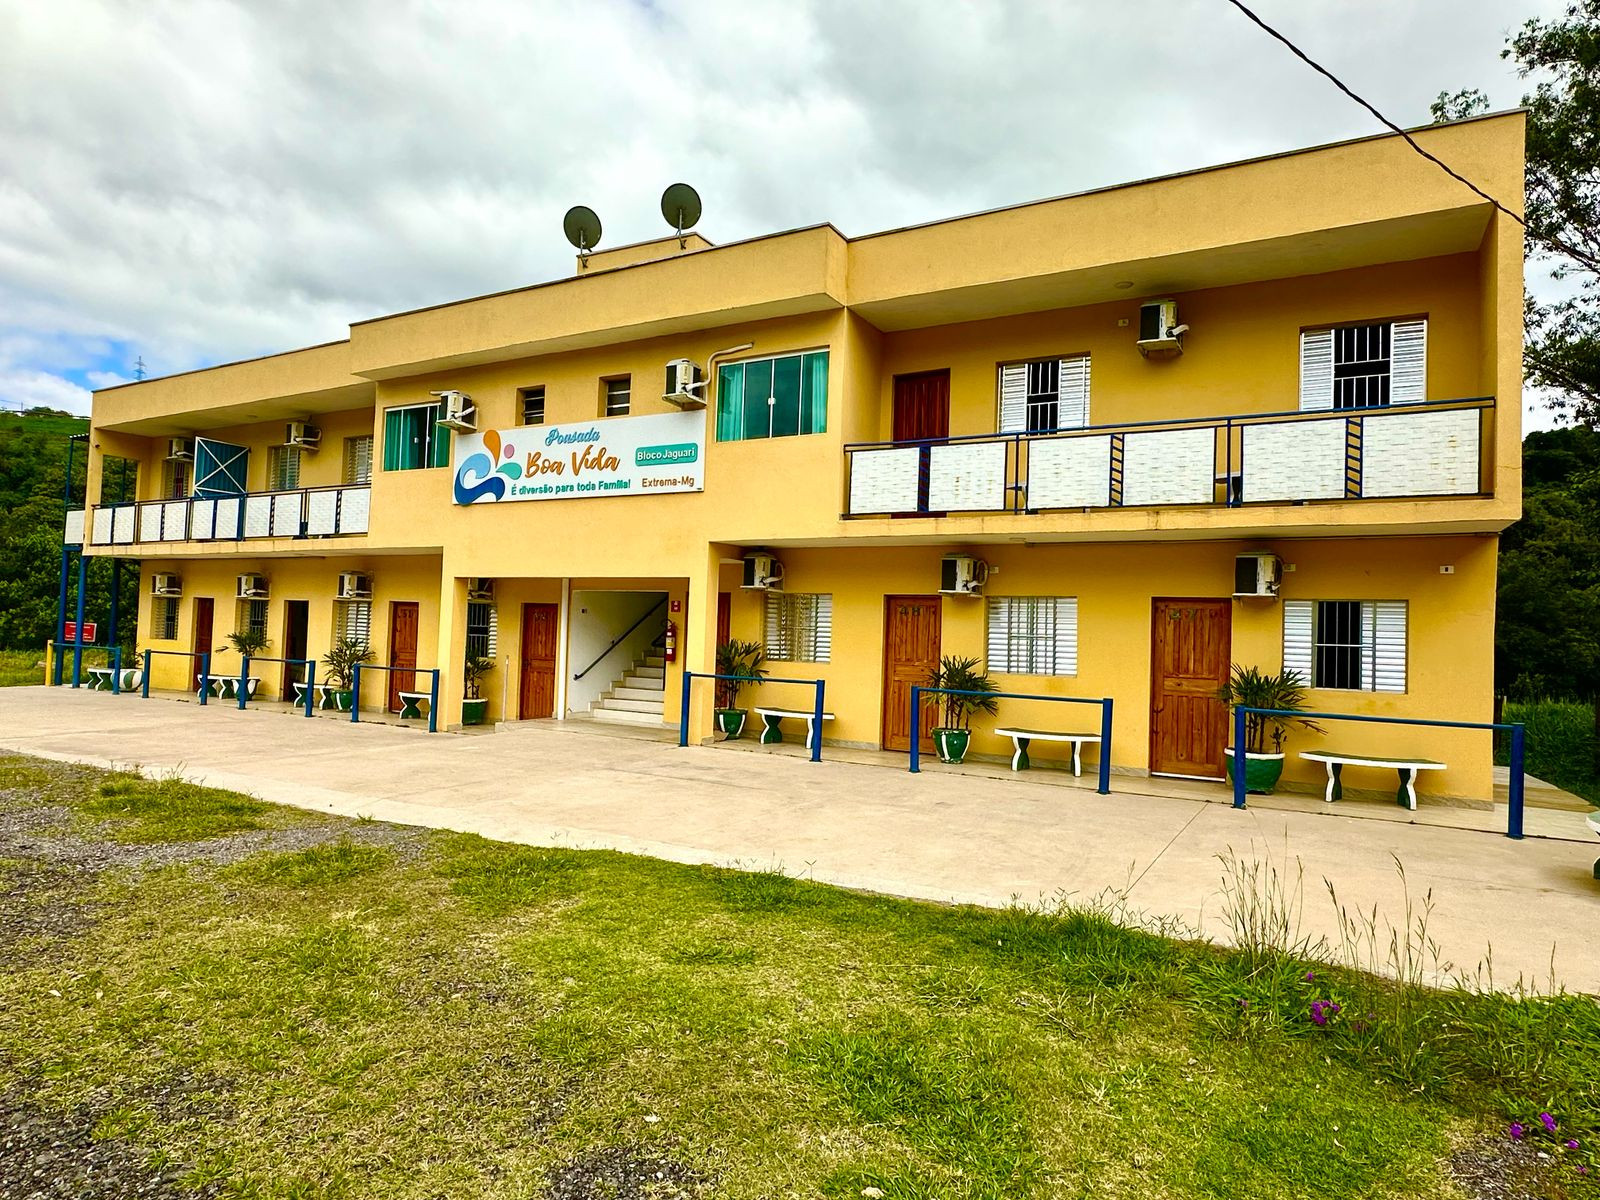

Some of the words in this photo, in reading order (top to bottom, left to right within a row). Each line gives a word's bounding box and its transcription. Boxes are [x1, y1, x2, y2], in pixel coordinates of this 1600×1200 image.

[545, 427, 600, 446] Pousada
[524, 451, 566, 479] Boa
[571, 444, 621, 477] Vida
[637, 451, 662, 461] Bloco
[662, 447, 695, 460] Jaguari
[511, 484, 517, 496] É
[518, 482, 553, 495] diversão
[555, 483, 575, 495] para
[577, 481, 596, 492] toda
[598, 479, 631, 490] Família!
[642, 476, 695, 488] Extrema-Mg
